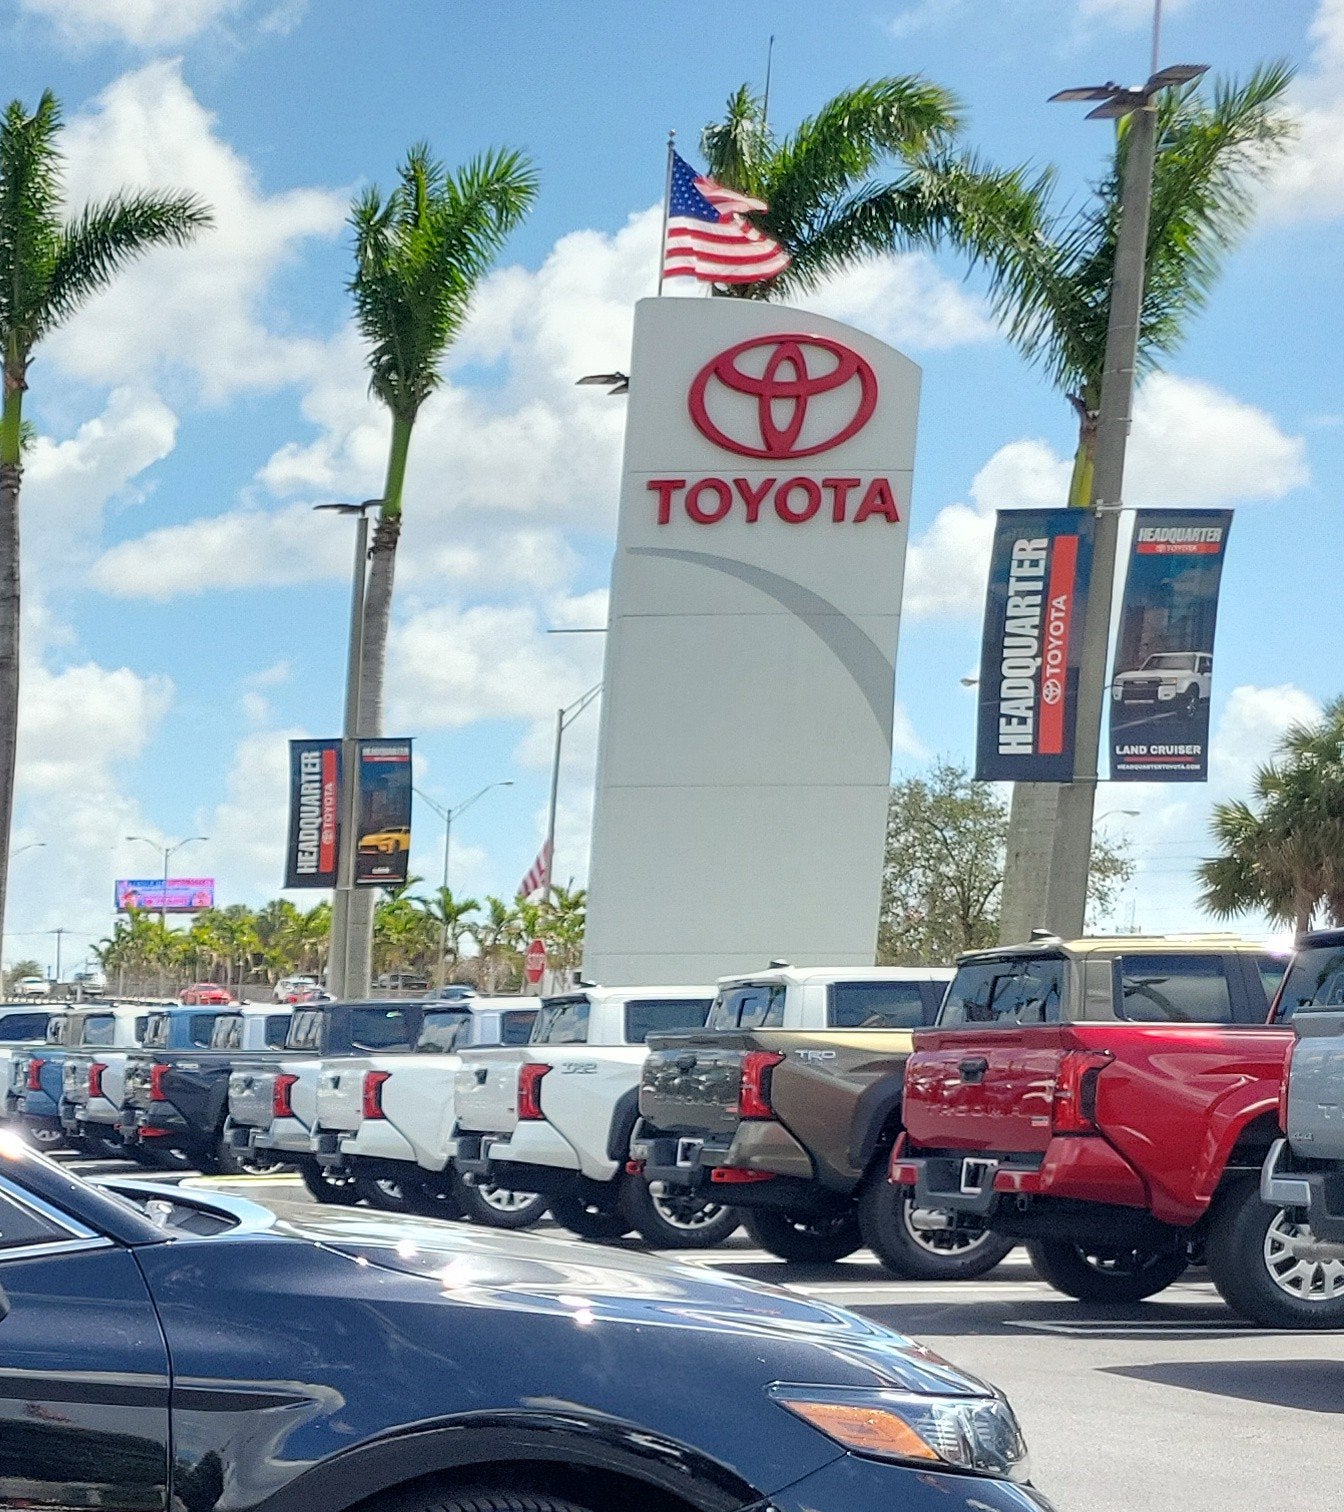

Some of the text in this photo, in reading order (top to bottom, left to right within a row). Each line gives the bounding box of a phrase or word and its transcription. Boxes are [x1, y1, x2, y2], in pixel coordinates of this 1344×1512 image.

[646, 476, 900, 525] TOYOTA
[1139, 527, 1223, 543] HEADQUARTER
[998, 537, 1049, 754] HEADQUARTER
[1046, 595, 1067, 677] TOYOTA
[1115, 745, 1201, 755] LAND CRUISER
[296, 751, 322, 873] HEADQUARTER
[323, 783, 333, 828] TOYOTA
[795, 1050, 836, 1061] TRD
